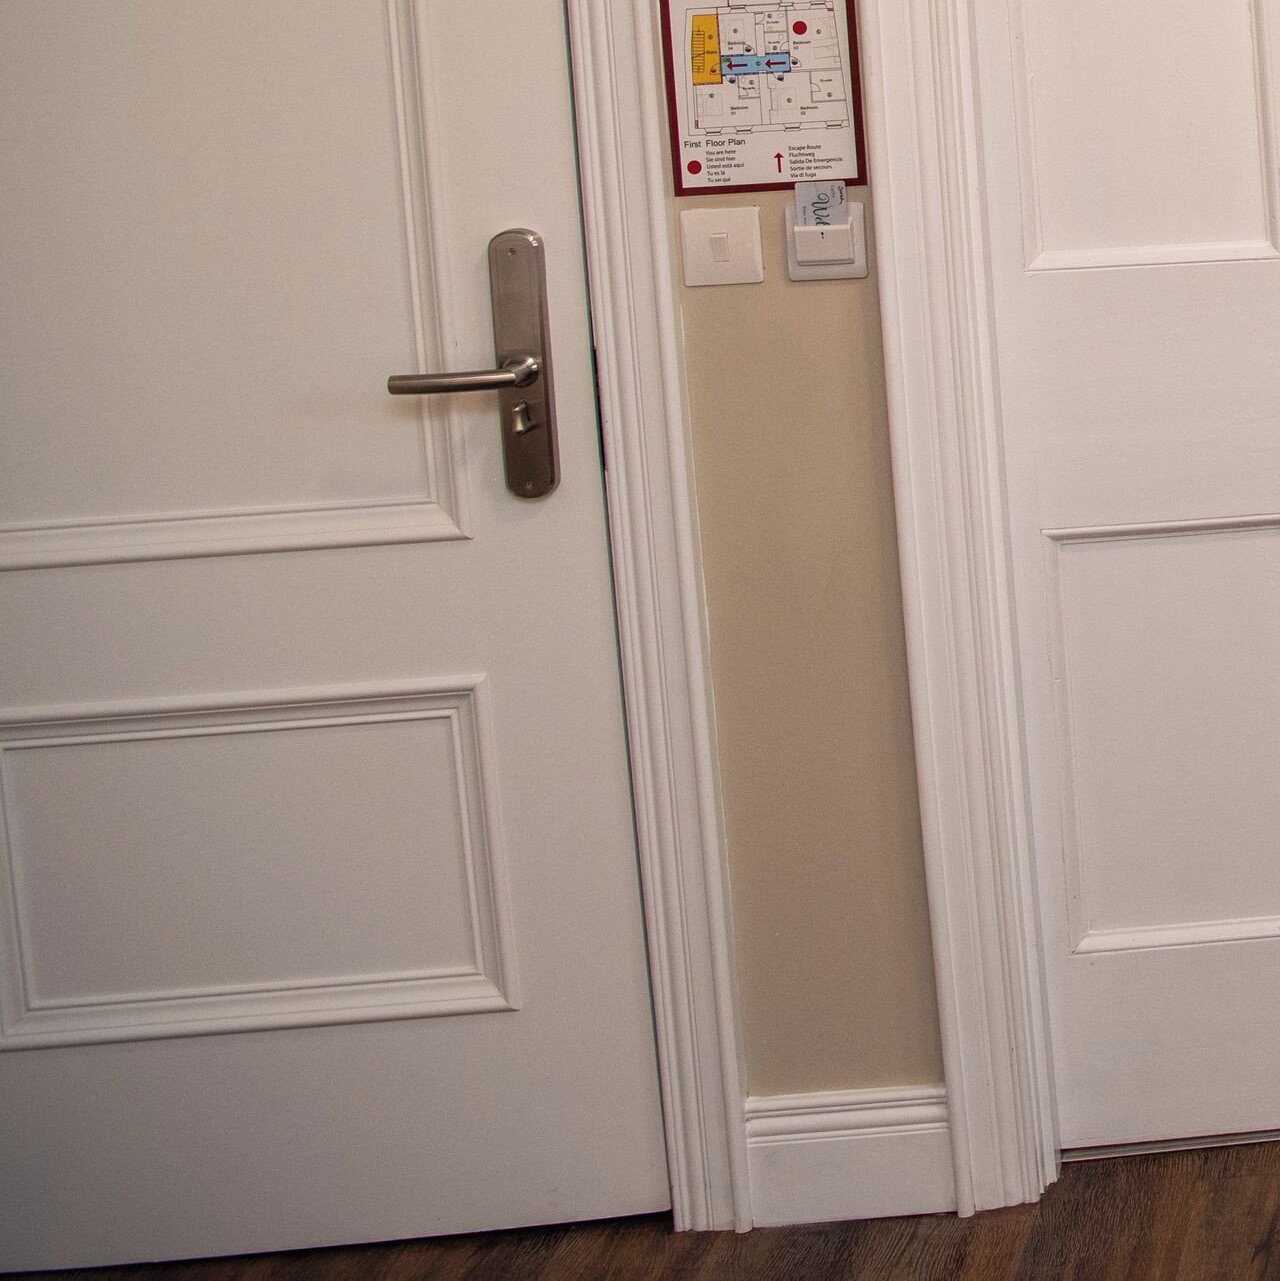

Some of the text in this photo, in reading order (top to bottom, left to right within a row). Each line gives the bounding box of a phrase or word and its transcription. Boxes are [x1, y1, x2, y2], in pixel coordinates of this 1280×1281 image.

[684, 138, 746, 149] First Floor Plan
